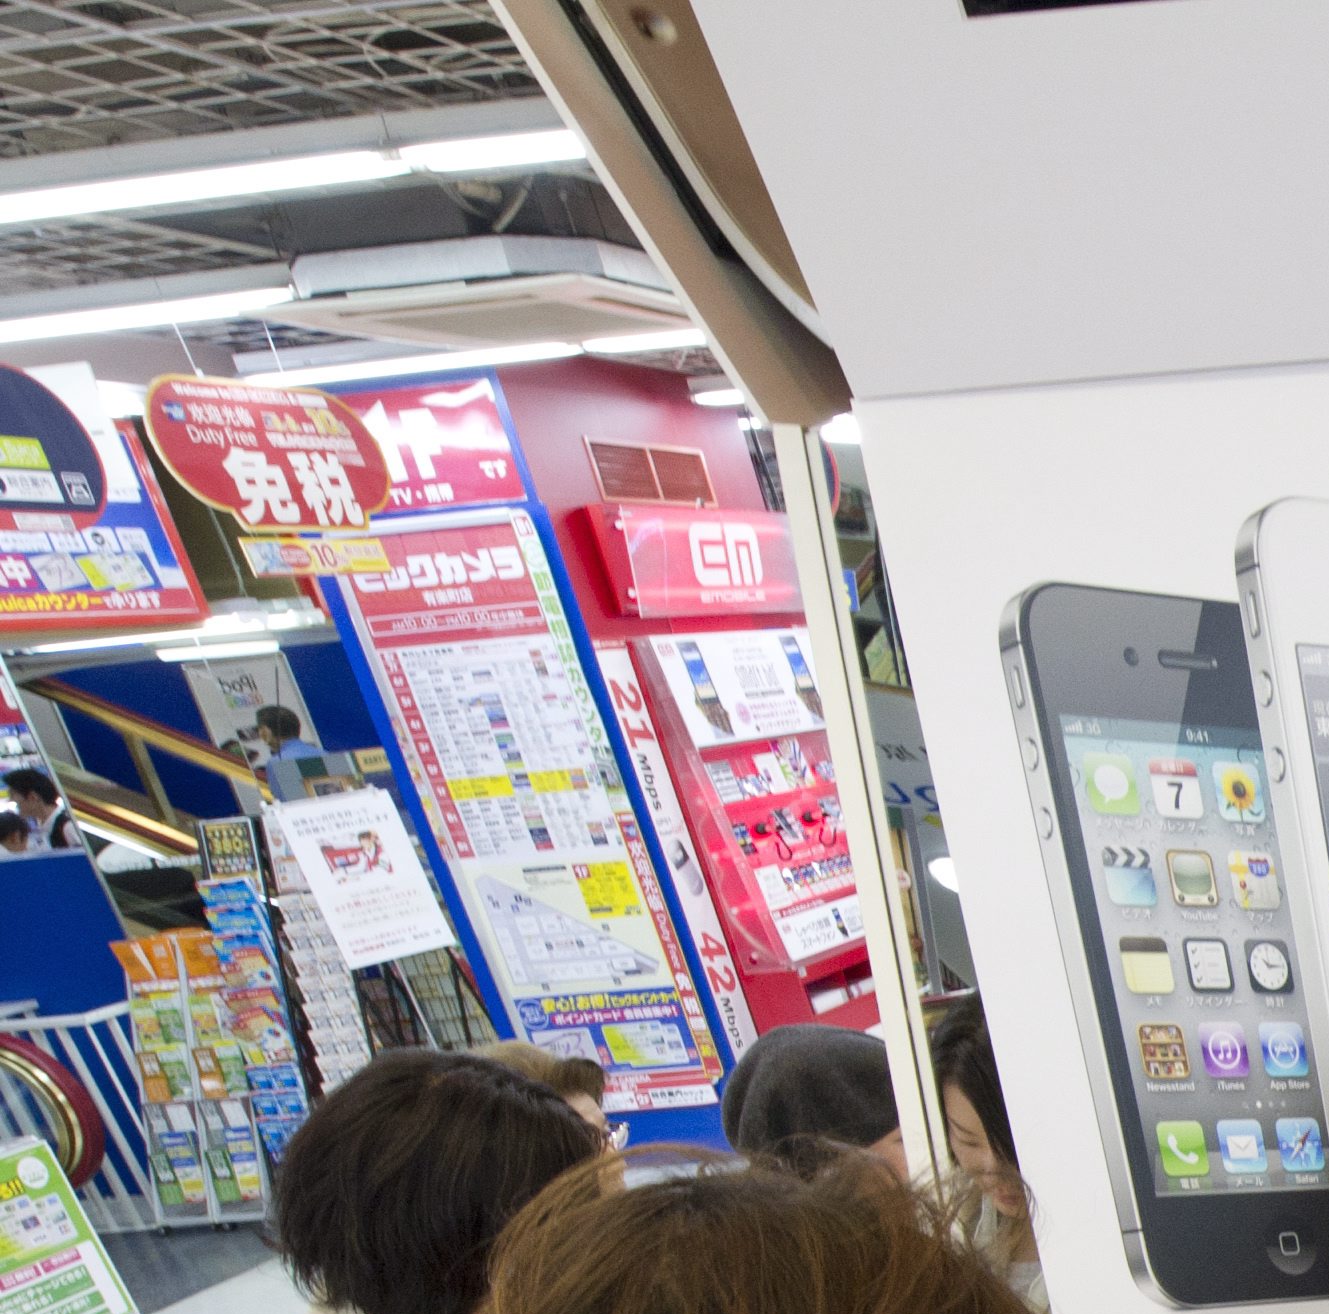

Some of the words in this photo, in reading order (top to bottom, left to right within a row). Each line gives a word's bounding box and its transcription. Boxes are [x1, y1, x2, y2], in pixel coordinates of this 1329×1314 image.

[186, 423, 224, 449] Duty
[227, 427, 259, 447] Free
[479, 459, 508, 479] です
[222, 446, 365, 527] 免税
[354, 545, 525, 593] ビックカメラ
[701, 590, 766, 603] EMOBILE
[1185, 728, 1211, 744] 9:41
[609, 677, 656, 750] 21
[638, 754, 663, 812] Mbps
[1167, 781, 1184, 810] 7
[1120, 908, 1154, 921] ビデオ
[1180, 909, 1219, 922] YouTube
[699, 931, 738, 995] 42
[720, 996, 746, 1050] Mbps
[1145, 1079, 1196, 1093] Newsstand
[1217, 1079, 1246, 1093] iTunes
[1269, 1079, 1289, 1094] App
[1290, 1078, 1311, 1091] Store
[1235, 1175, 1264, 1188] メール
[1294, 1172, 1319, 1185] Safari
